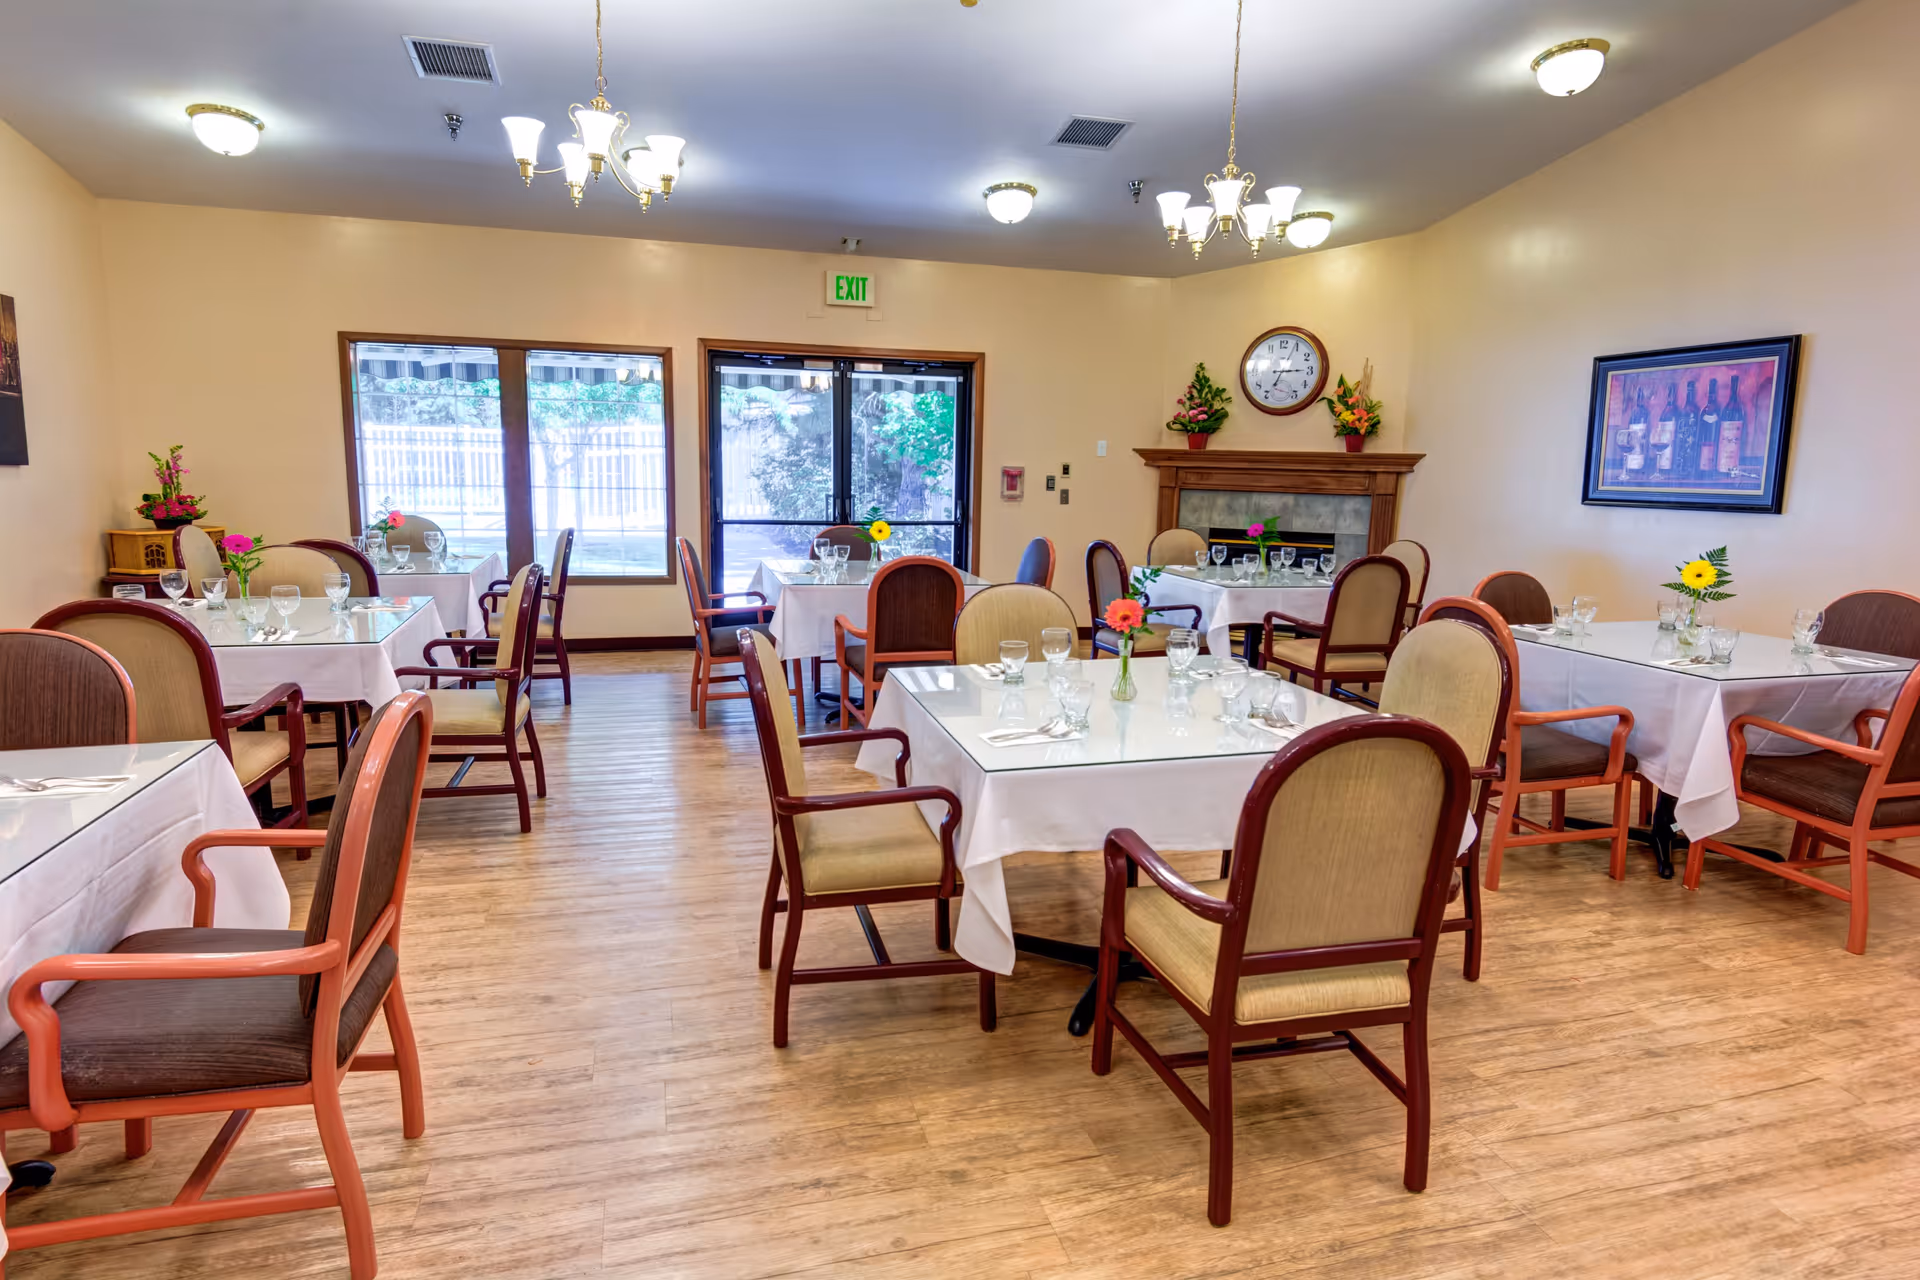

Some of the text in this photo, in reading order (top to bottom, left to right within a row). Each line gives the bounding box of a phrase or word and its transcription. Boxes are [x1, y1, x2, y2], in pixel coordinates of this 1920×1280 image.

[836, 275, 868, 301] EXIT
[1279, 340, 1288, 349] 12
[1303, 352, 1311, 362] 2
[1306, 366, 1314, 376] 3
[1301, 380, 1308, 389] 4
[1291, 390, 1298, 399] 5
